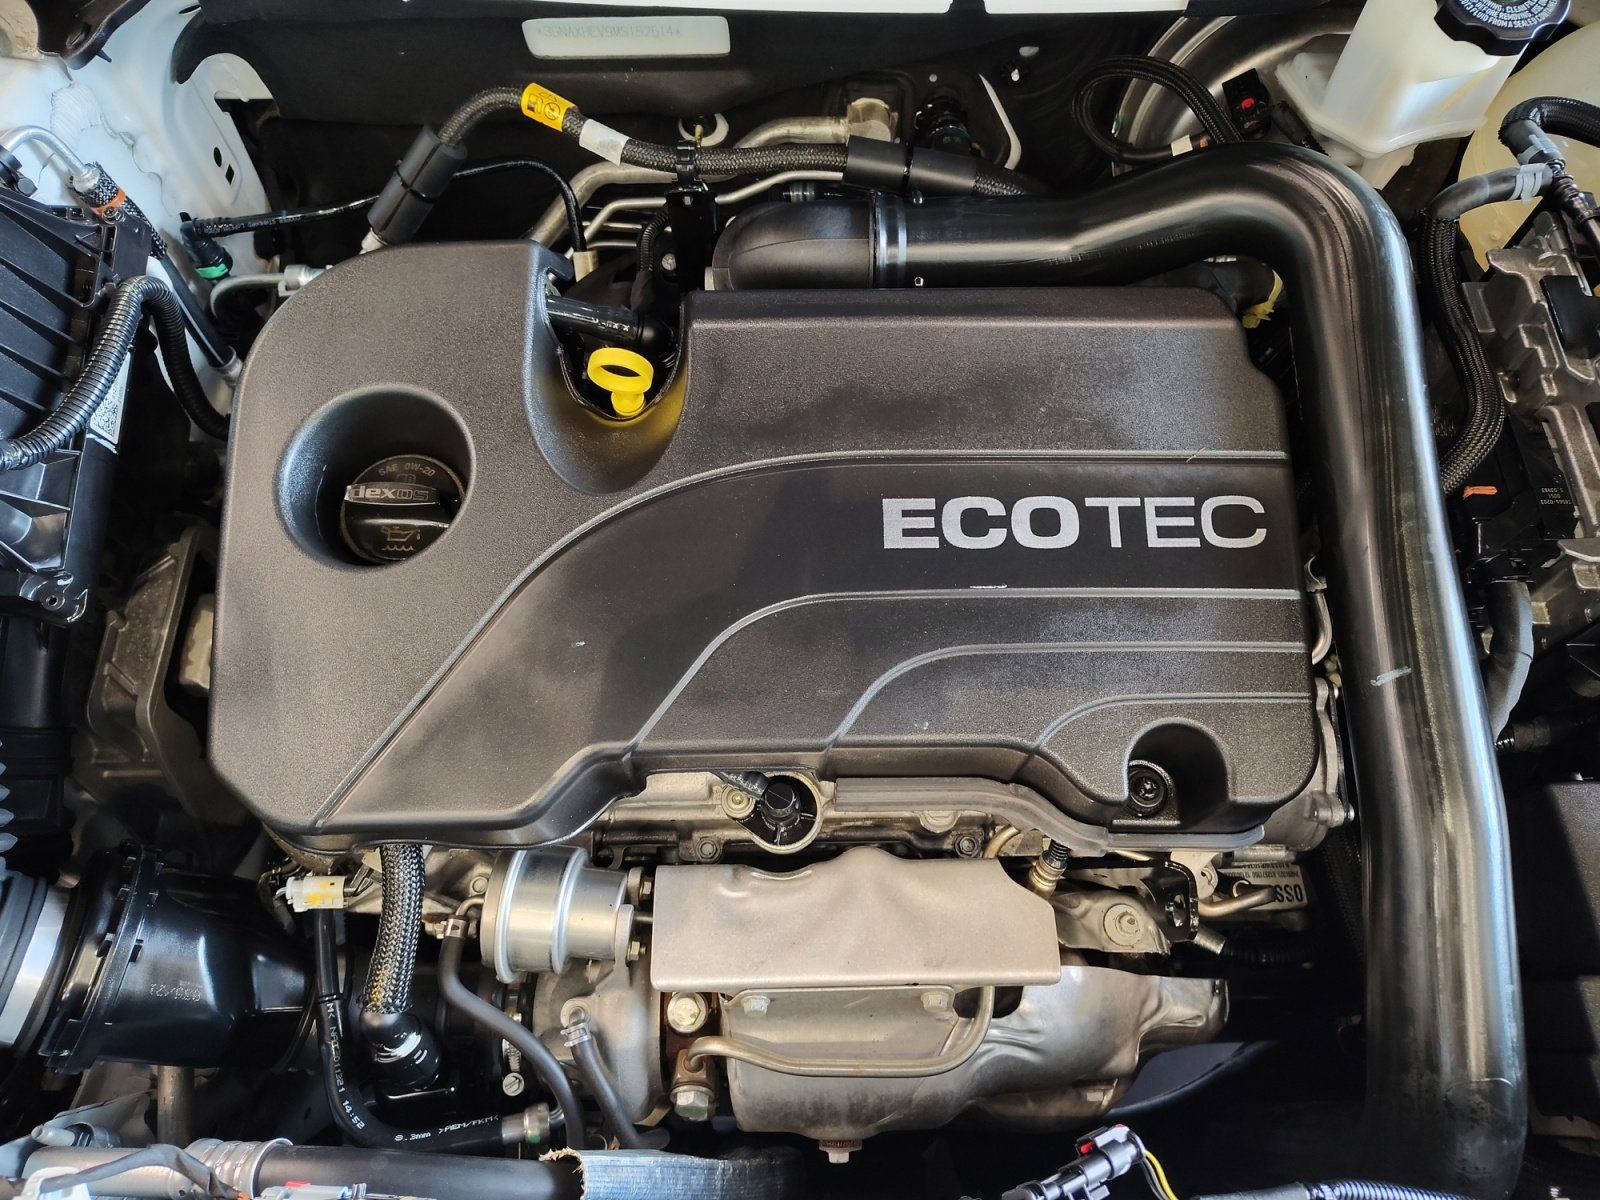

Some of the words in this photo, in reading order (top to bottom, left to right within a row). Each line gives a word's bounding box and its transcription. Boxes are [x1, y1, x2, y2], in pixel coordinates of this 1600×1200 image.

[1470, 7, 1489, 21] FLUID
[1488, 16, 1507, 27] FROM
[378, 463, 399, 476] SAE
[404, 463, 436, 477] 0W-20
[349, 485, 429, 501] dexos
[882, 495, 1267, 549] ECOTEC
[342, 1099, 365, 1130] 14:52
